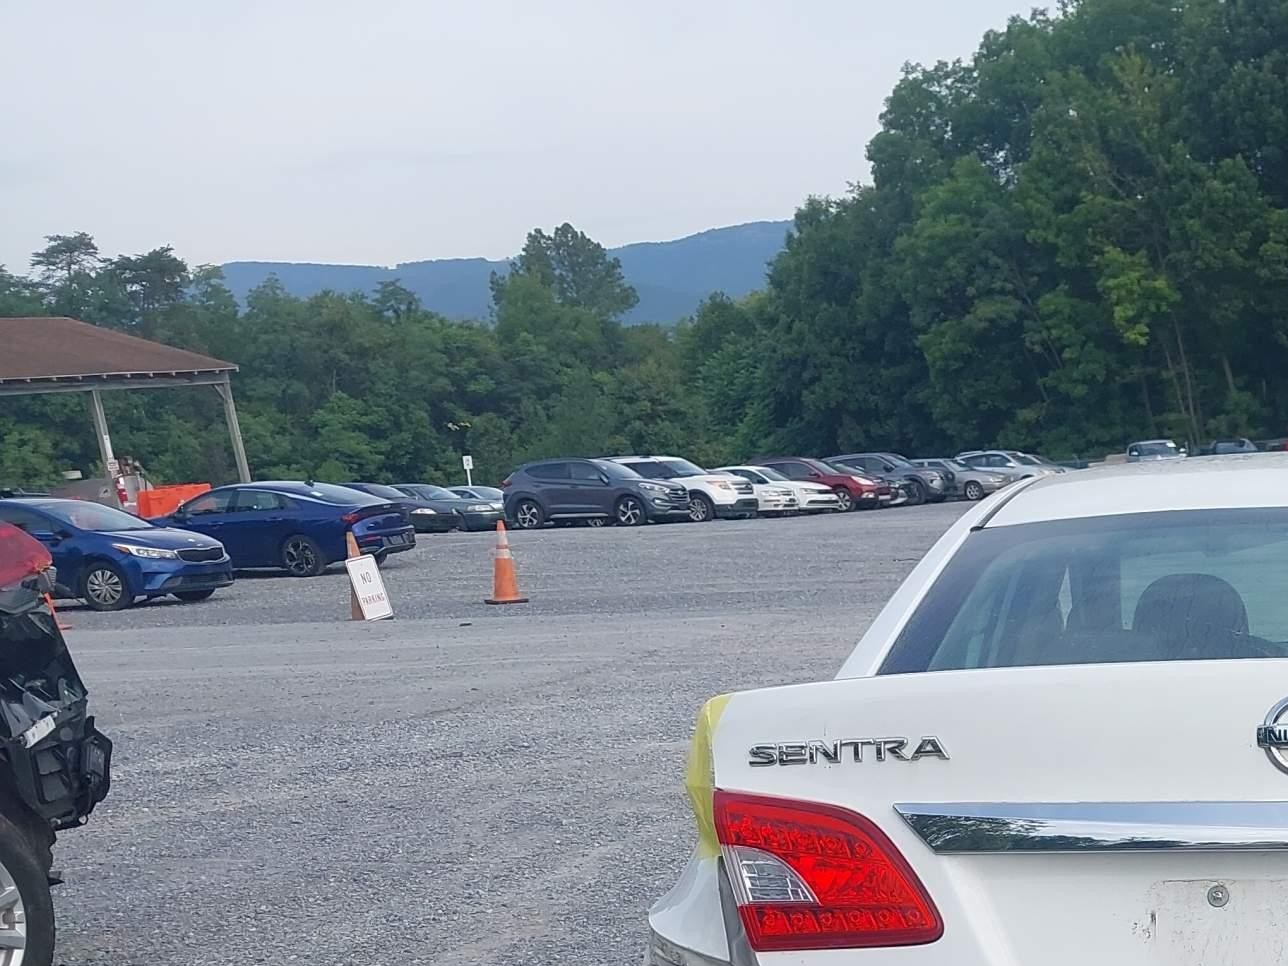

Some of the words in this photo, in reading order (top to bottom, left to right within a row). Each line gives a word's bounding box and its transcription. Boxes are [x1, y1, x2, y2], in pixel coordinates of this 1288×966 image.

[360, 571, 372, 585] NO
[362, 593, 385, 604] PARKING
[749, 736, 951, 767] SENTRA
